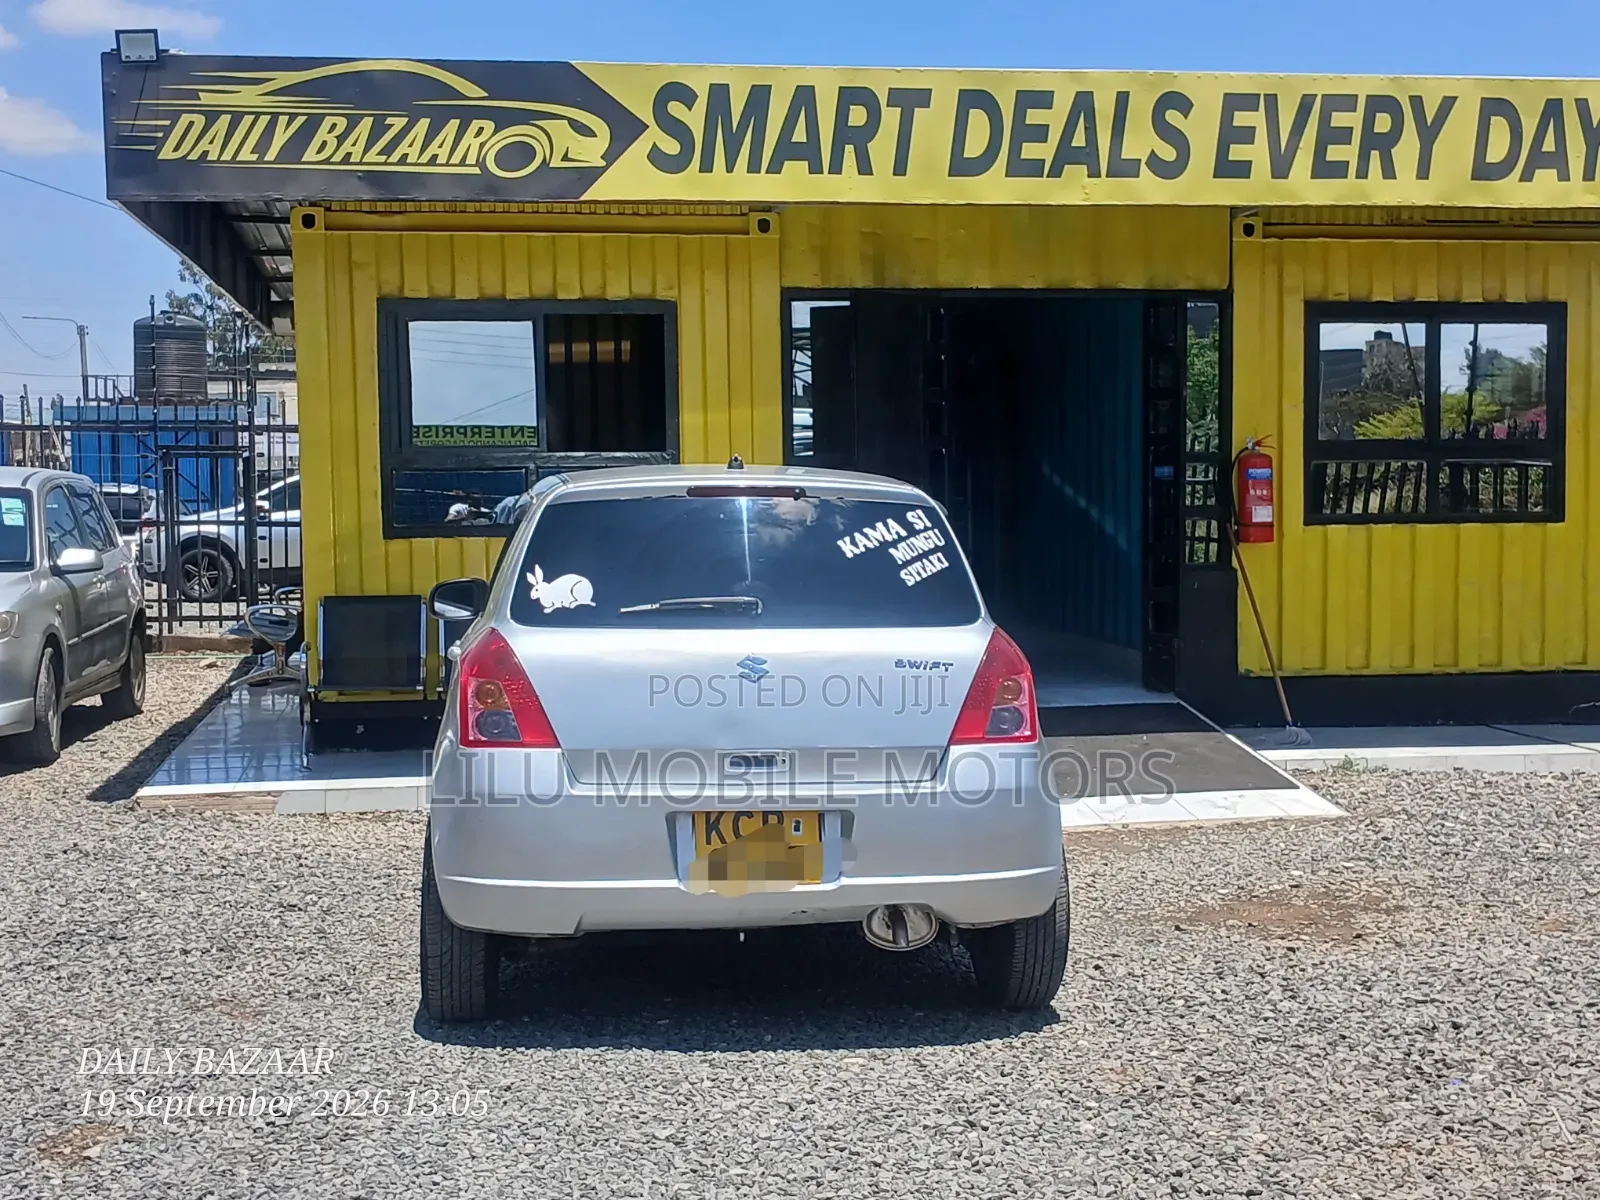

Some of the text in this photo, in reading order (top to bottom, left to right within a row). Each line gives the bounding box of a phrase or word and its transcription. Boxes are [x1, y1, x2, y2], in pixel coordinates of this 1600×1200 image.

[157, 113, 492, 166] DAILY BAZAAR
[646, 81, 1600, 183] SMART DEALS EVERY DAY
[836, 509, 932, 558] KAMA SI
[888, 528, 946, 565] MUNGU
[900, 552, 949, 587] SITAKI
[894, 658, 954, 672] SWIFT
